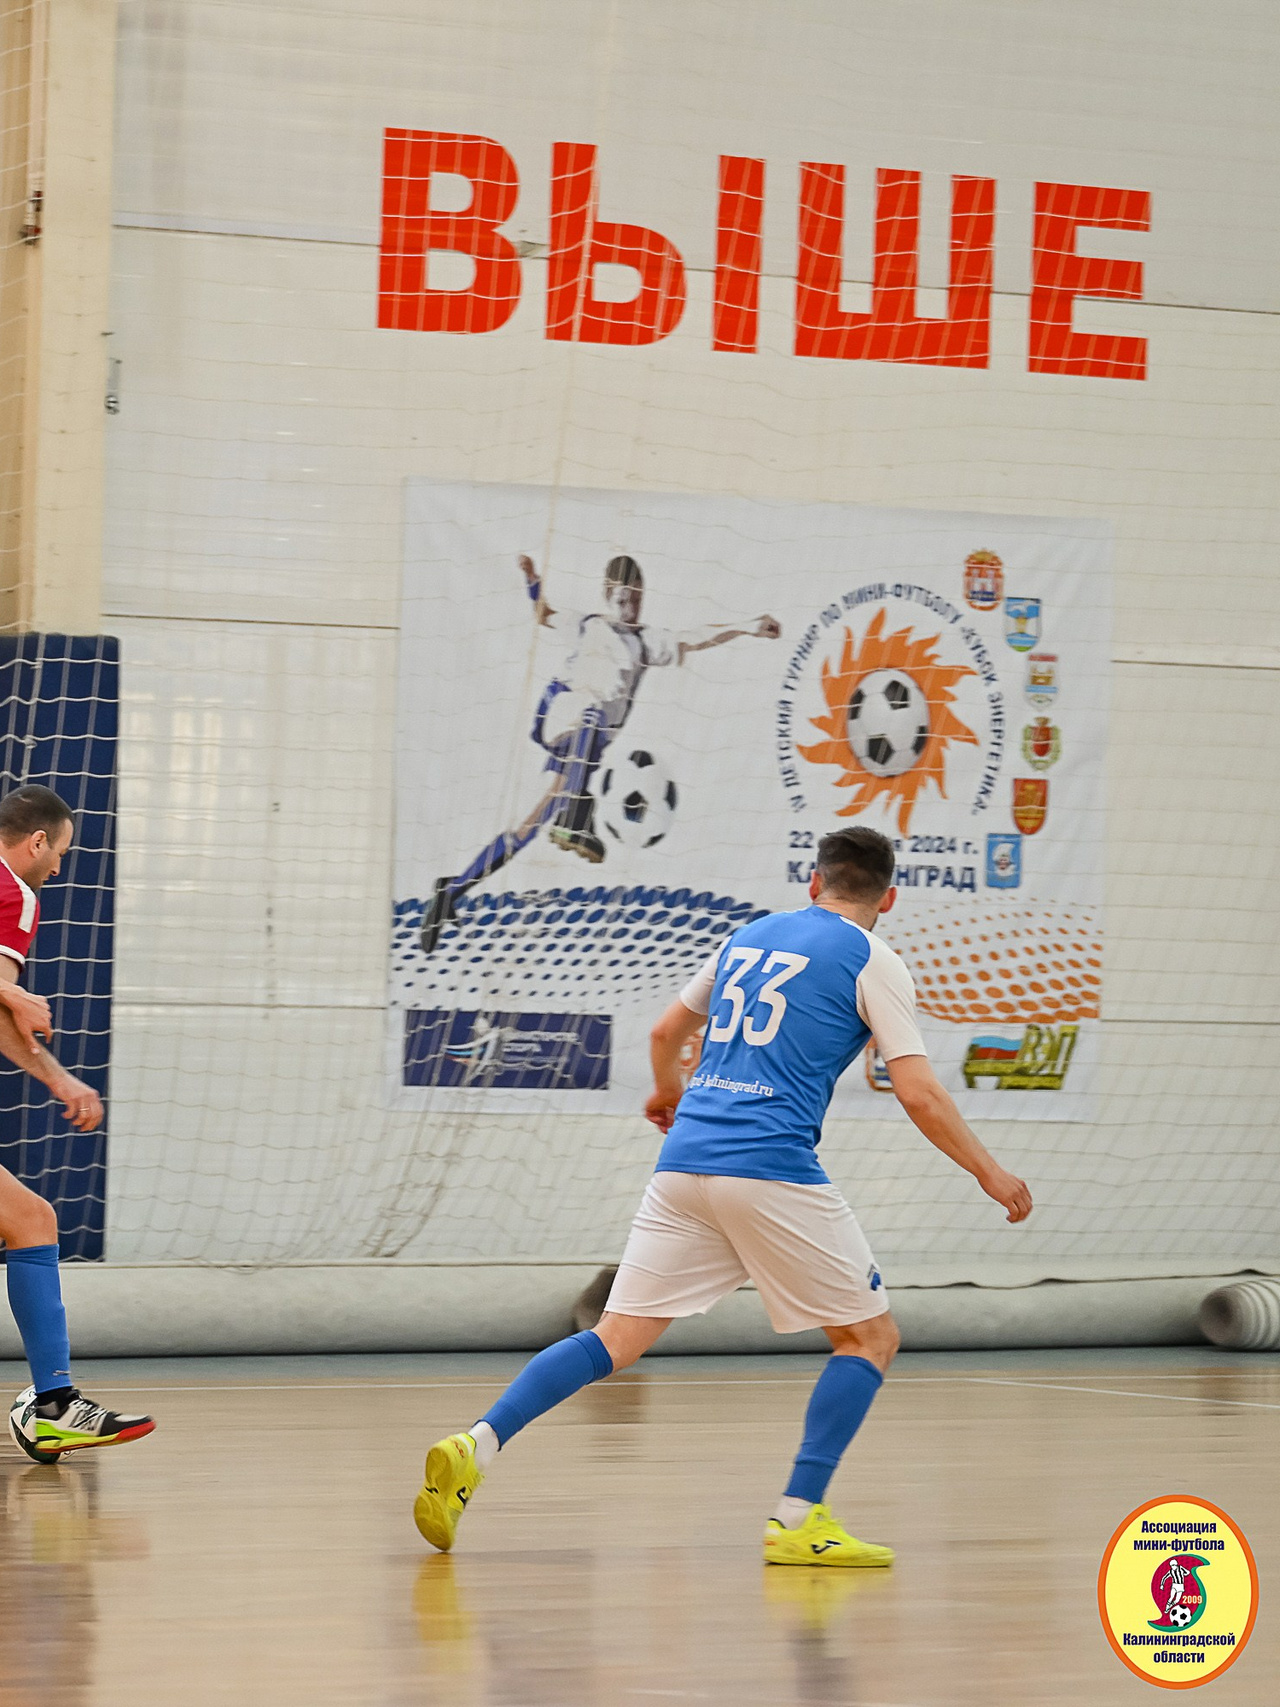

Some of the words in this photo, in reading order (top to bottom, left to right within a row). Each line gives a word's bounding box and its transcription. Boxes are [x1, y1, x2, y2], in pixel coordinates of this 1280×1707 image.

[376, 126, 1152, 382] ВЫШЕ
[788, 830, 814, 849] 22
[910, 835, 957, 854] 2024
[962, 841, 979, 855] г.
[708, 946, 811, 1047] 33
